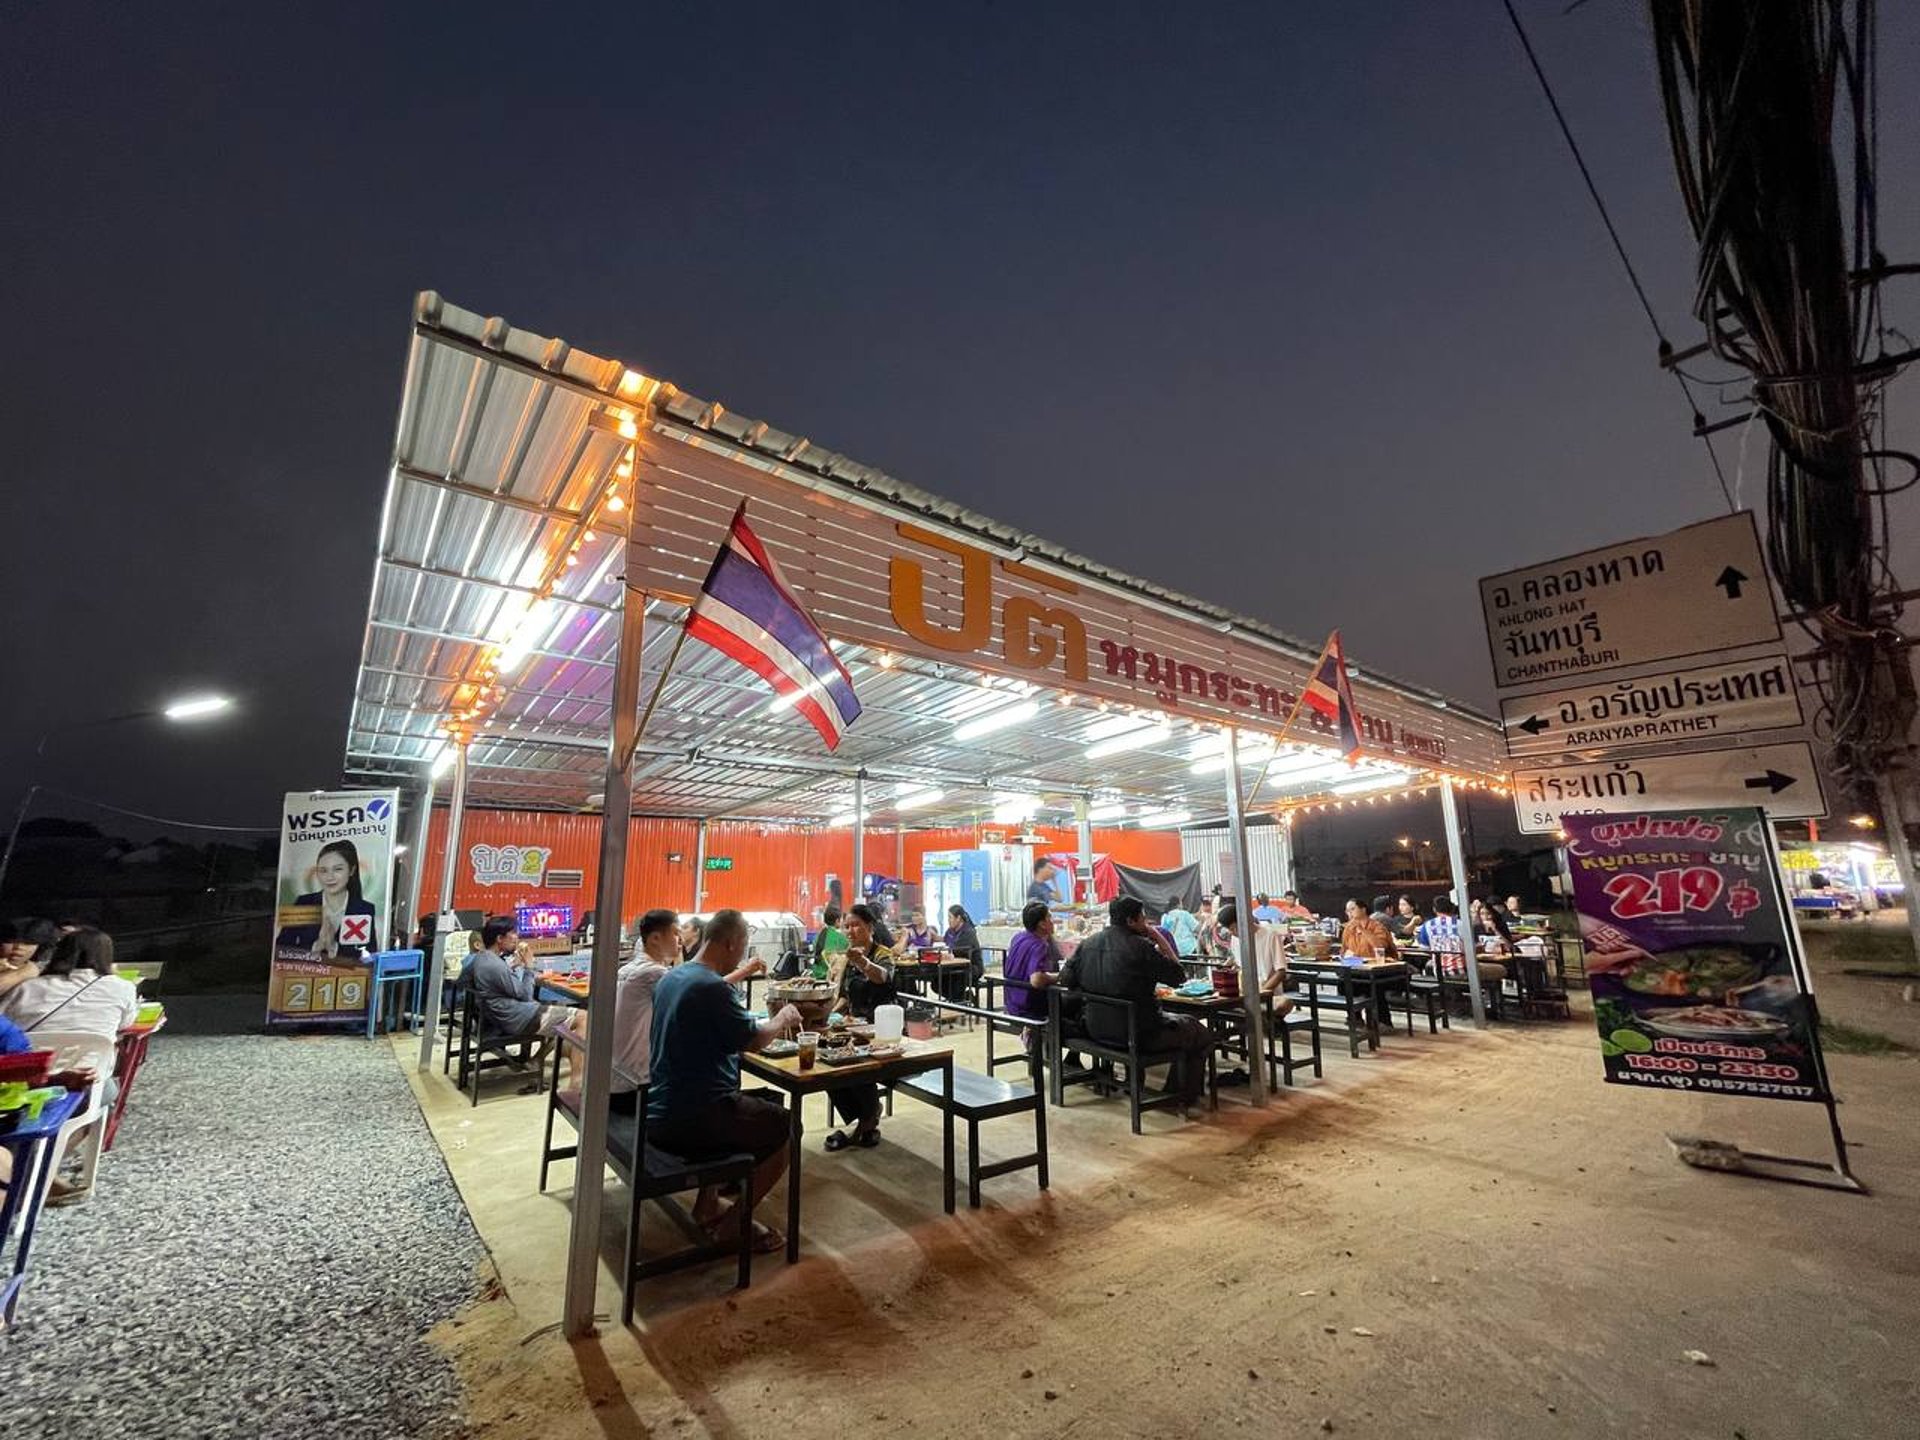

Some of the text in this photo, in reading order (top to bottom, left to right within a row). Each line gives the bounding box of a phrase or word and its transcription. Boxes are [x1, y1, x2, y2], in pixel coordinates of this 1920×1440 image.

[1498, 598, 1586, 628] KHLONG HAT
[1504, 612, 1602, 658] จันทบุรี
[1507, 649, 1620, 680] CHANTHABURI
[1566, 714, 1720, 746] ARANYAPRATHET
[1528, 763, 1647, 803] สระแก้ว
[288, 807, 364, 830] พรรค
[1533, 812, 1554, 825] SA
[1602, 866, 1724, 920] 219
[1625, 1055, 1699, 1072] 16:00
[1719, 1061, 1799, 1081] 23:30
